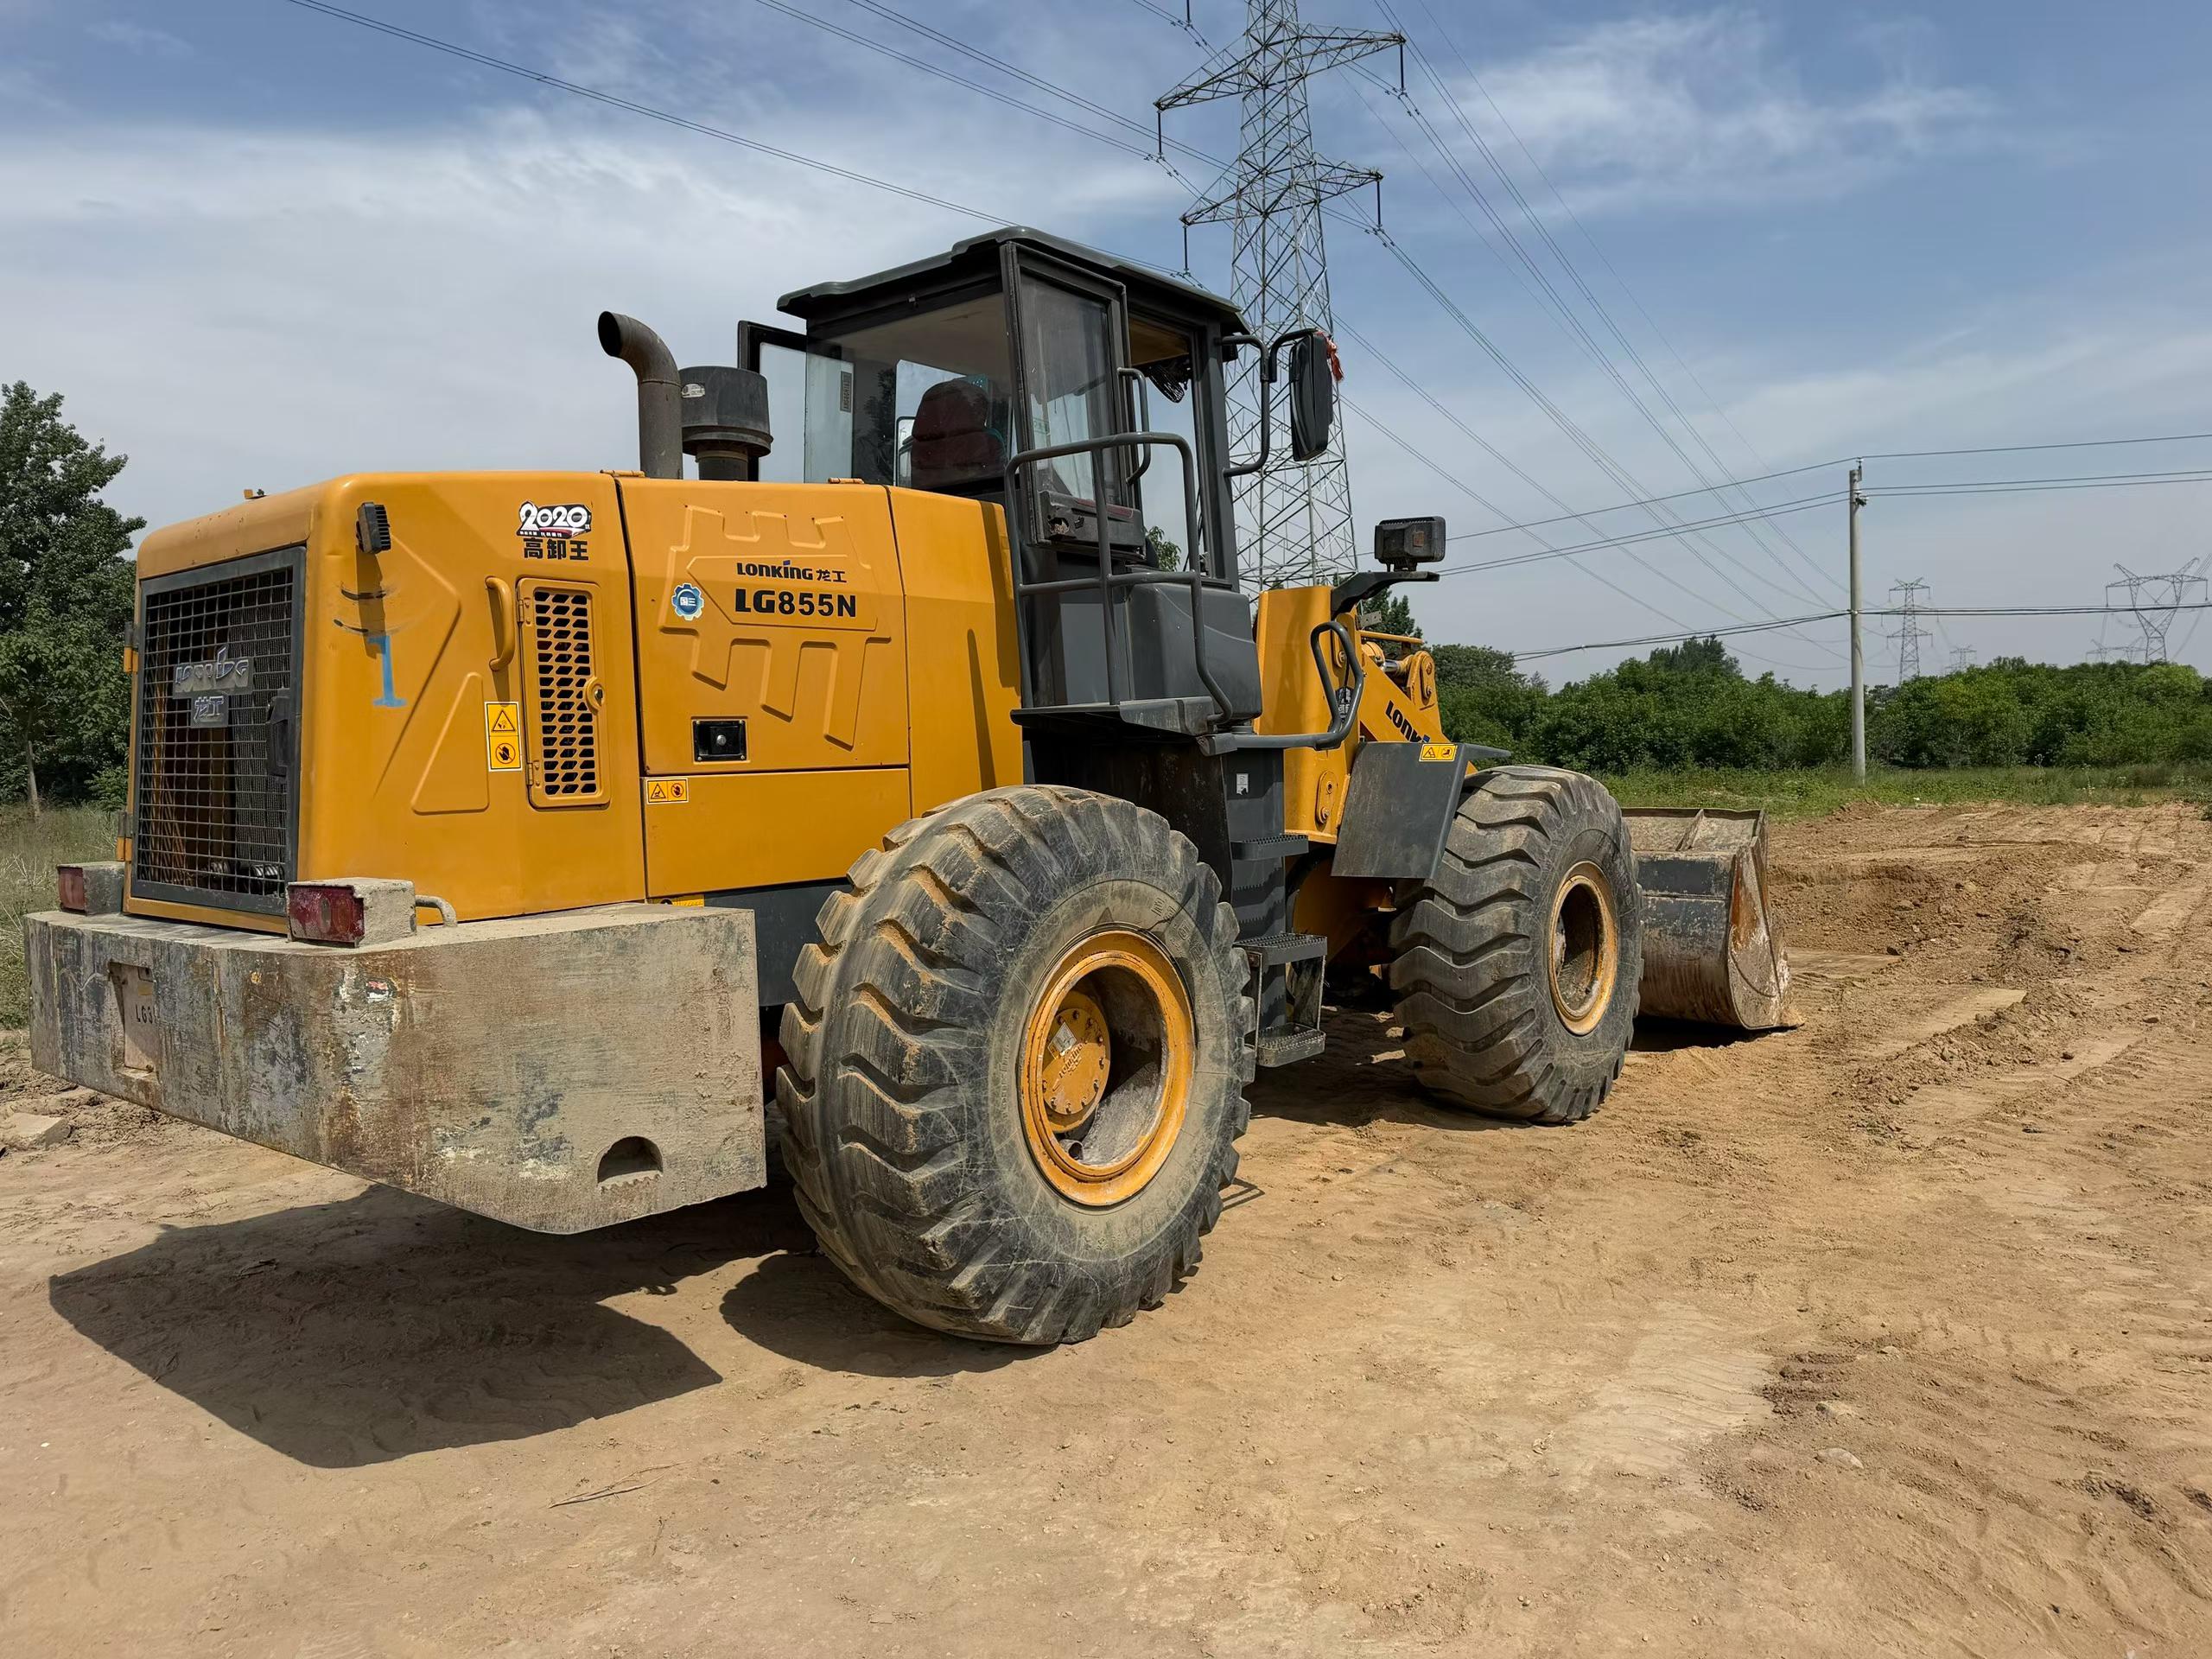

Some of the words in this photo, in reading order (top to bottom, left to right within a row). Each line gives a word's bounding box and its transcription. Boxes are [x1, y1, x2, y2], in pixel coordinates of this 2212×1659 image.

[519, 503, 588, 531] 2020
[523, 537, 589, 561] 高卸王
[816, 569, 847, 583] 龙工
[735, 588, 856, 618] LG855N
